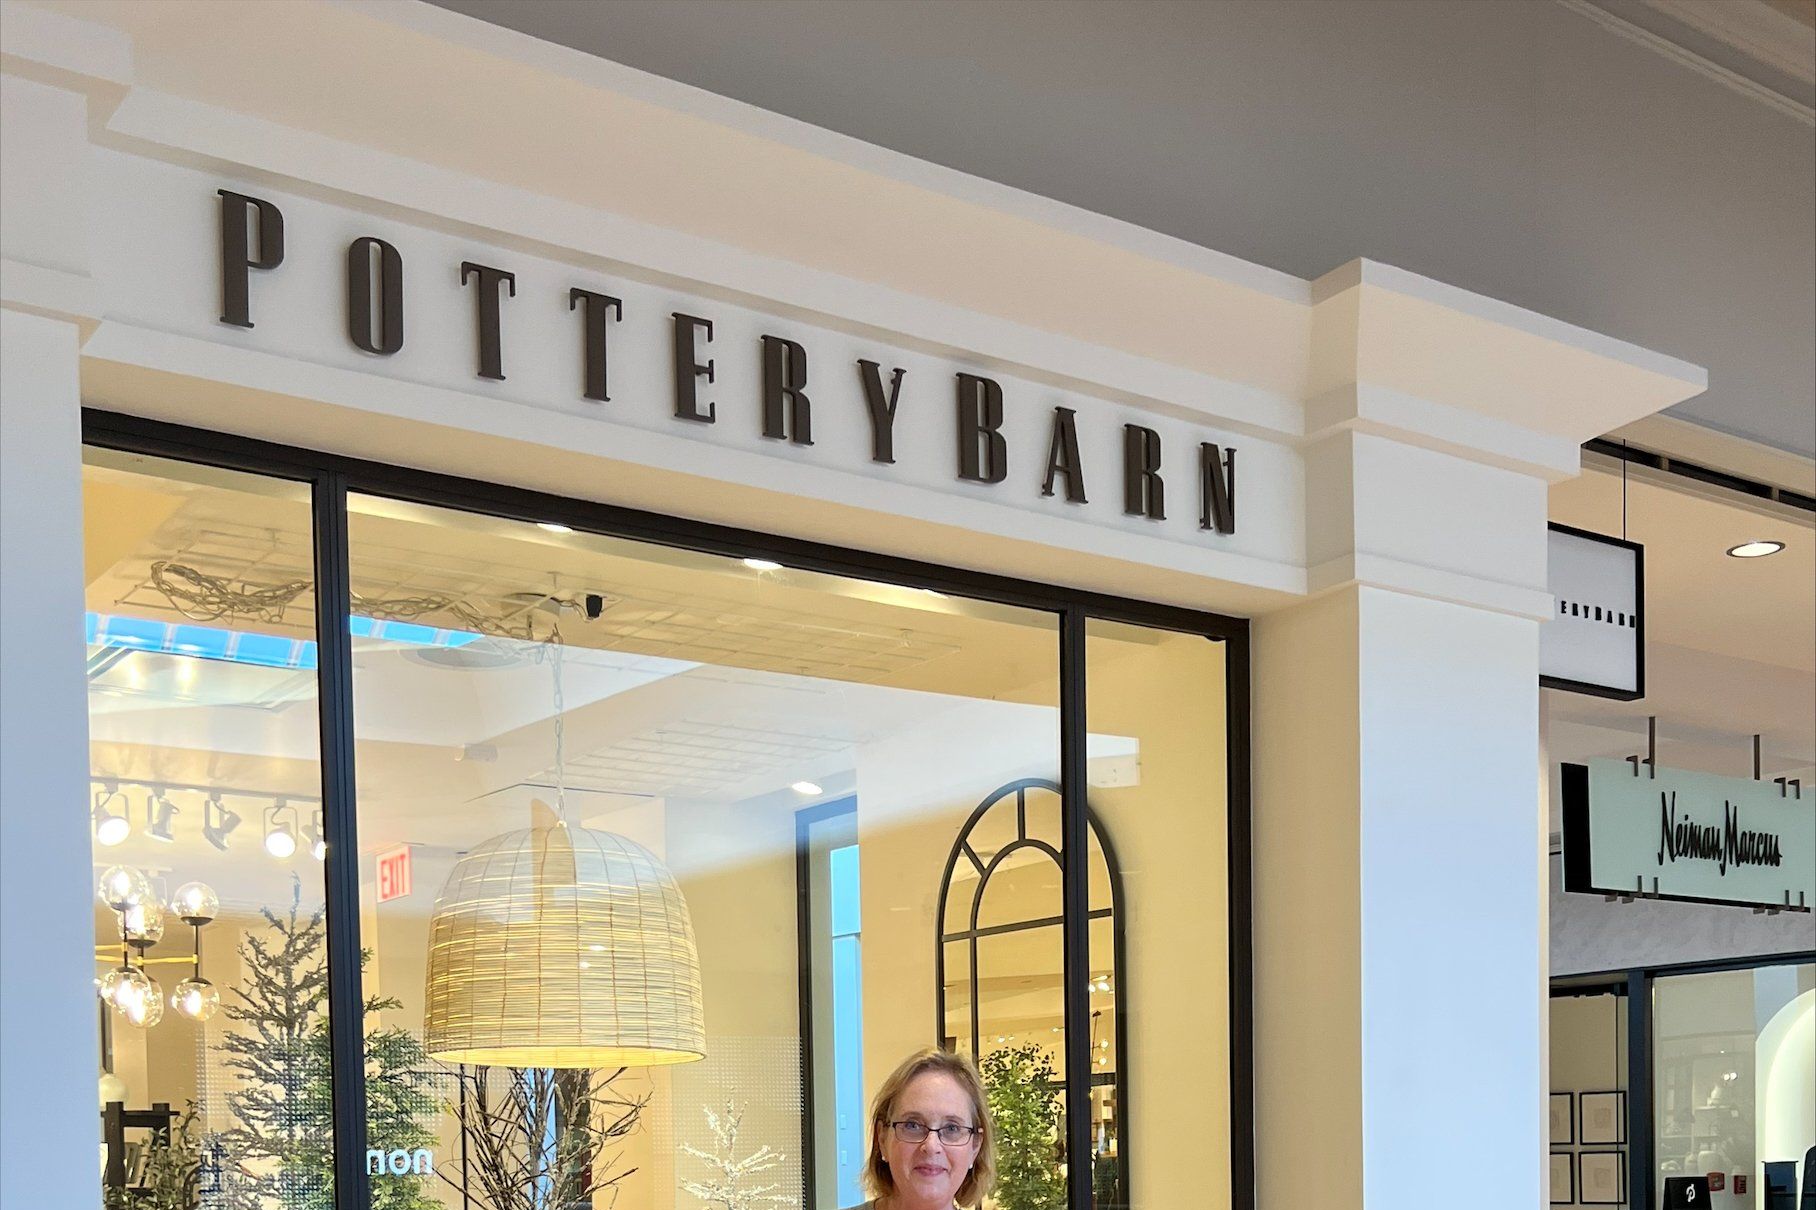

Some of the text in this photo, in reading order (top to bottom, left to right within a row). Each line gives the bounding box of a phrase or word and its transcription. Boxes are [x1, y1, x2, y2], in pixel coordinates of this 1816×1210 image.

[1658, 791, 1783, 877] Neiman Marcus
[380, 854, 407, 899] EXIT
